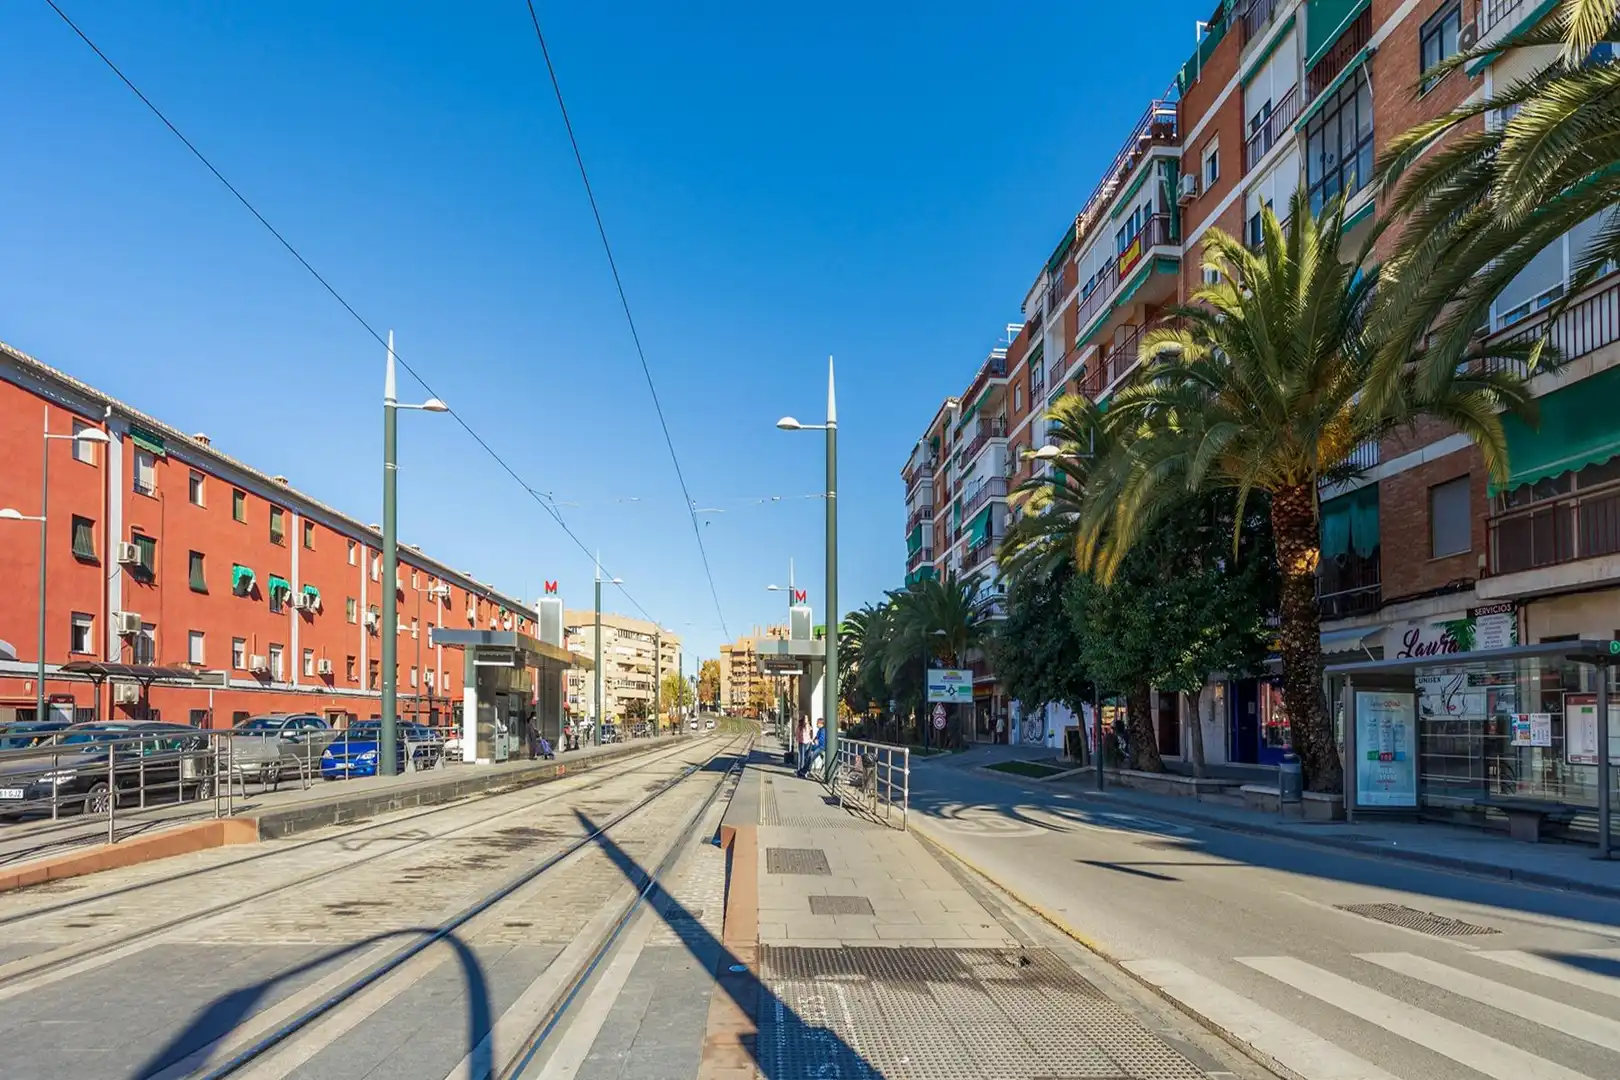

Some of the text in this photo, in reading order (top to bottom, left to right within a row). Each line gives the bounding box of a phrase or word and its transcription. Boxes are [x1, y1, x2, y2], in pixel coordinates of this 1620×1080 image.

[545, 581, 557, 594] M
[796, 590, 806, 603] M
[1474, 604, 1511, 616] SERVICIOS
[1397, 628, 1461, 658] Laura
